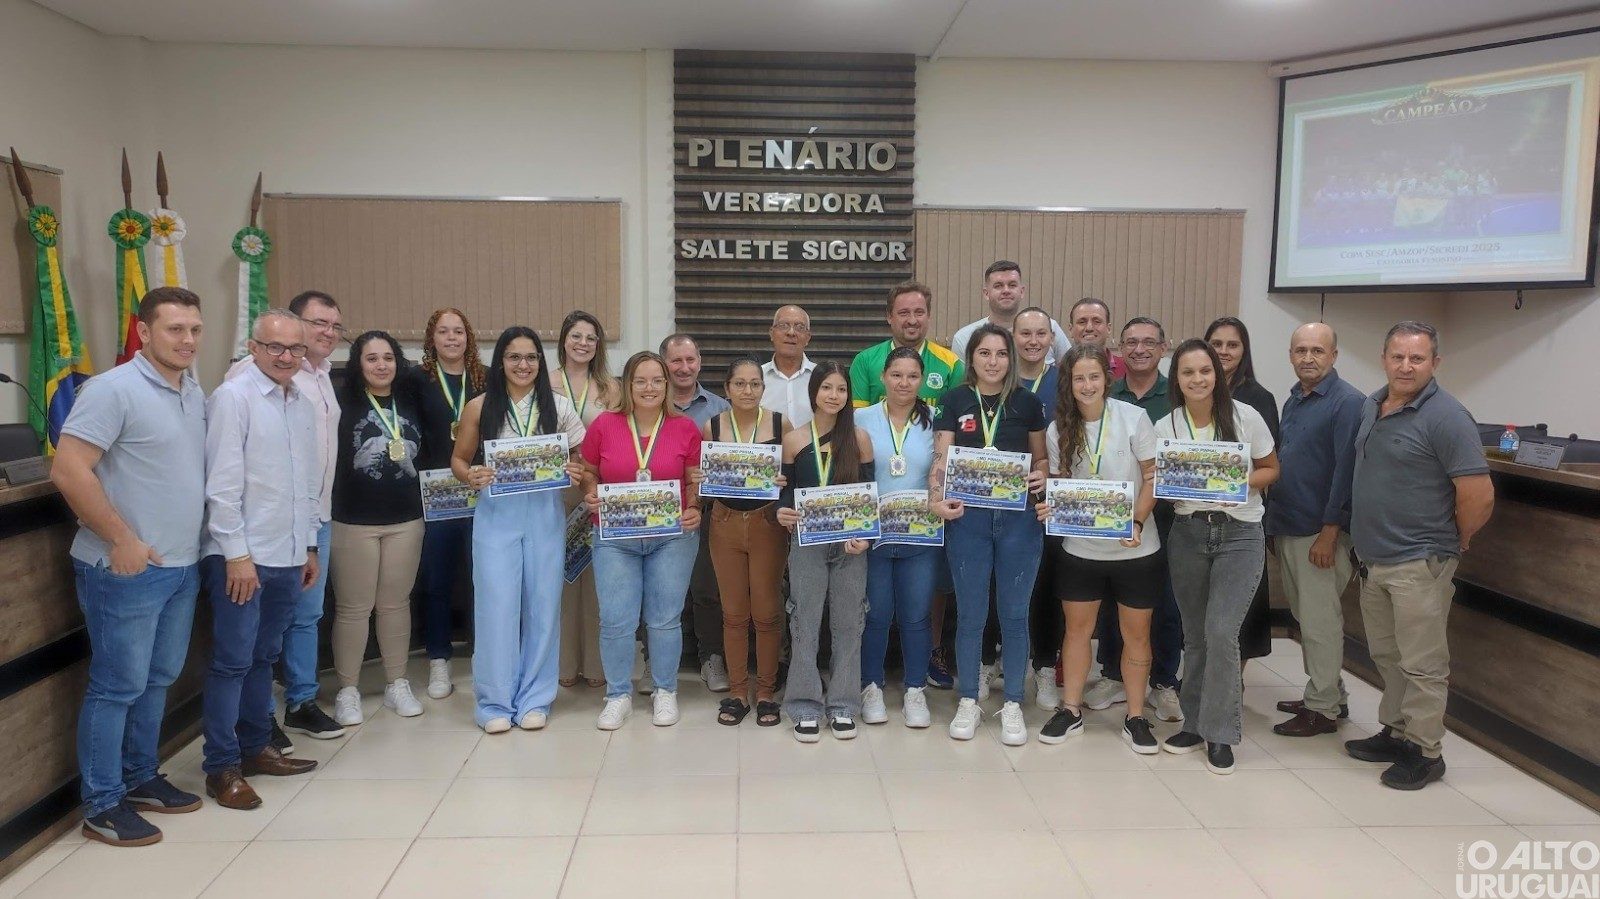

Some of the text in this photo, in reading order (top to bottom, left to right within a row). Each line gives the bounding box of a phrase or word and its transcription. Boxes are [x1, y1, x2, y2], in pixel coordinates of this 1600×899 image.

[1383, 99, 1473, 121] CAMPEÃO
[688, 127, 897, 172] PLENÁRIO
[702, 191, 884, 213] VEREADORA
[681, 239, 907, 261] SALETE SIGNOR
[495, 443, 562, 460] CAMPEÃO
[710, 452, 776, 467] CAMPEÃO
[1166, 449, 1242, 466] CAMPEÃO
[956, 458, 1024, 475] CAMPEÃO
[607, 489, 675, 505] CAMPEÃO
[804, 492, 872, 508] CAMPEÃO
[1056, 490, 1127, 505] CAMPEÃO
